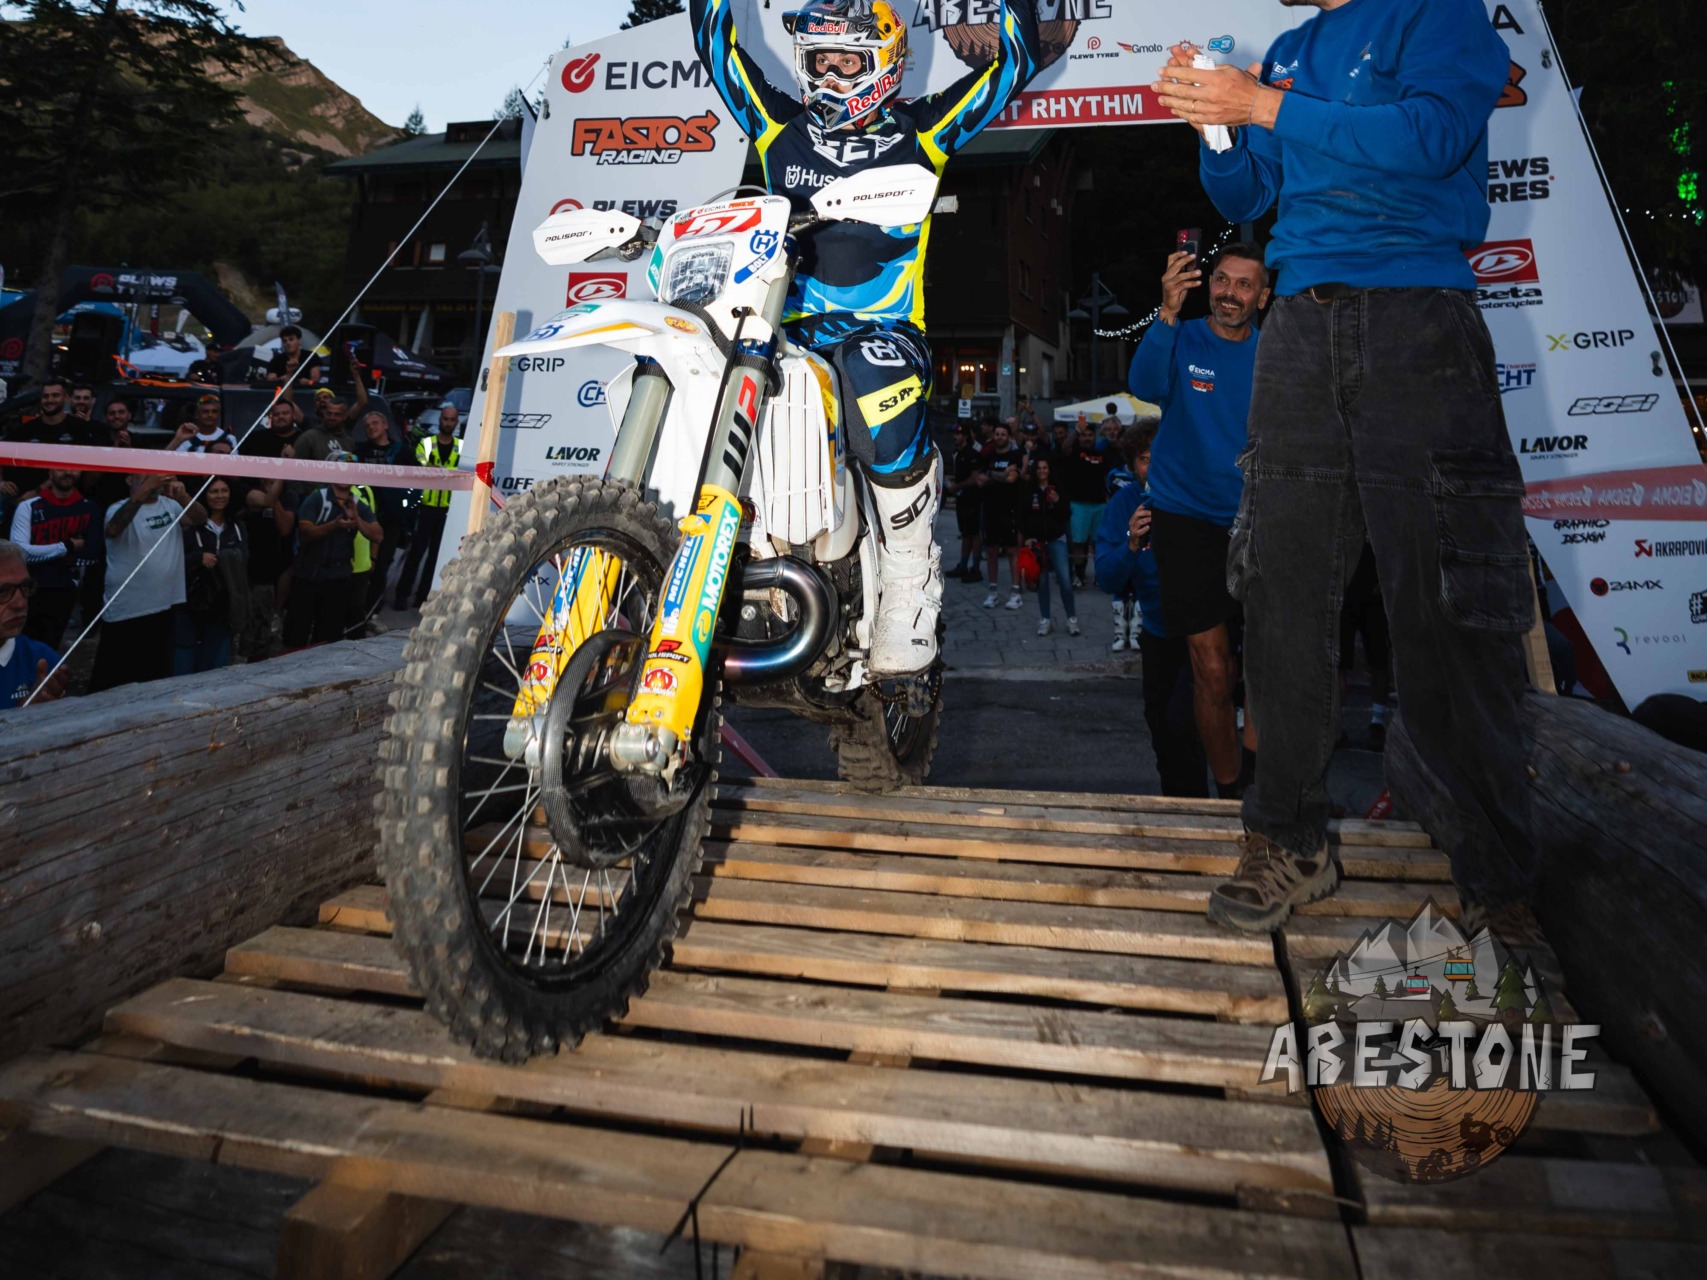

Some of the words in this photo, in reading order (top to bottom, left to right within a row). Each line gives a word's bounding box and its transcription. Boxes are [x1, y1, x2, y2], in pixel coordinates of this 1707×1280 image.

[808, 22, 828, 33] Red
[827, 23, 846, 33] Bull
[1131, 44, 1163, 54] Gmoto
[605, 60, 712, 90] EICM
[847, 81, 882, 117] Red
[1031, 93, 1143, 120] RHYTHM
[597, 150, 683, 165] RACING
[684, 208, 758, 237] 57
[545, 231, 592, 242] POLISPOR
[747, 255, 771, 274] BOLT
[118, 274, 178, 287] PLWS
[1479, 299, 1543, 309] otorcycles
[507, 357, 565, 372] -GRIP
[879, 396, 898, 412] S3
[1520, 435, 1588, 453] LAVOR
[545, 446, 600, 461] LAVOR
[502, 477, 534, 490] OFF
[701, 508, 740, 611] MOTOREX
[1610, 580, 1664, 591] 24MX
